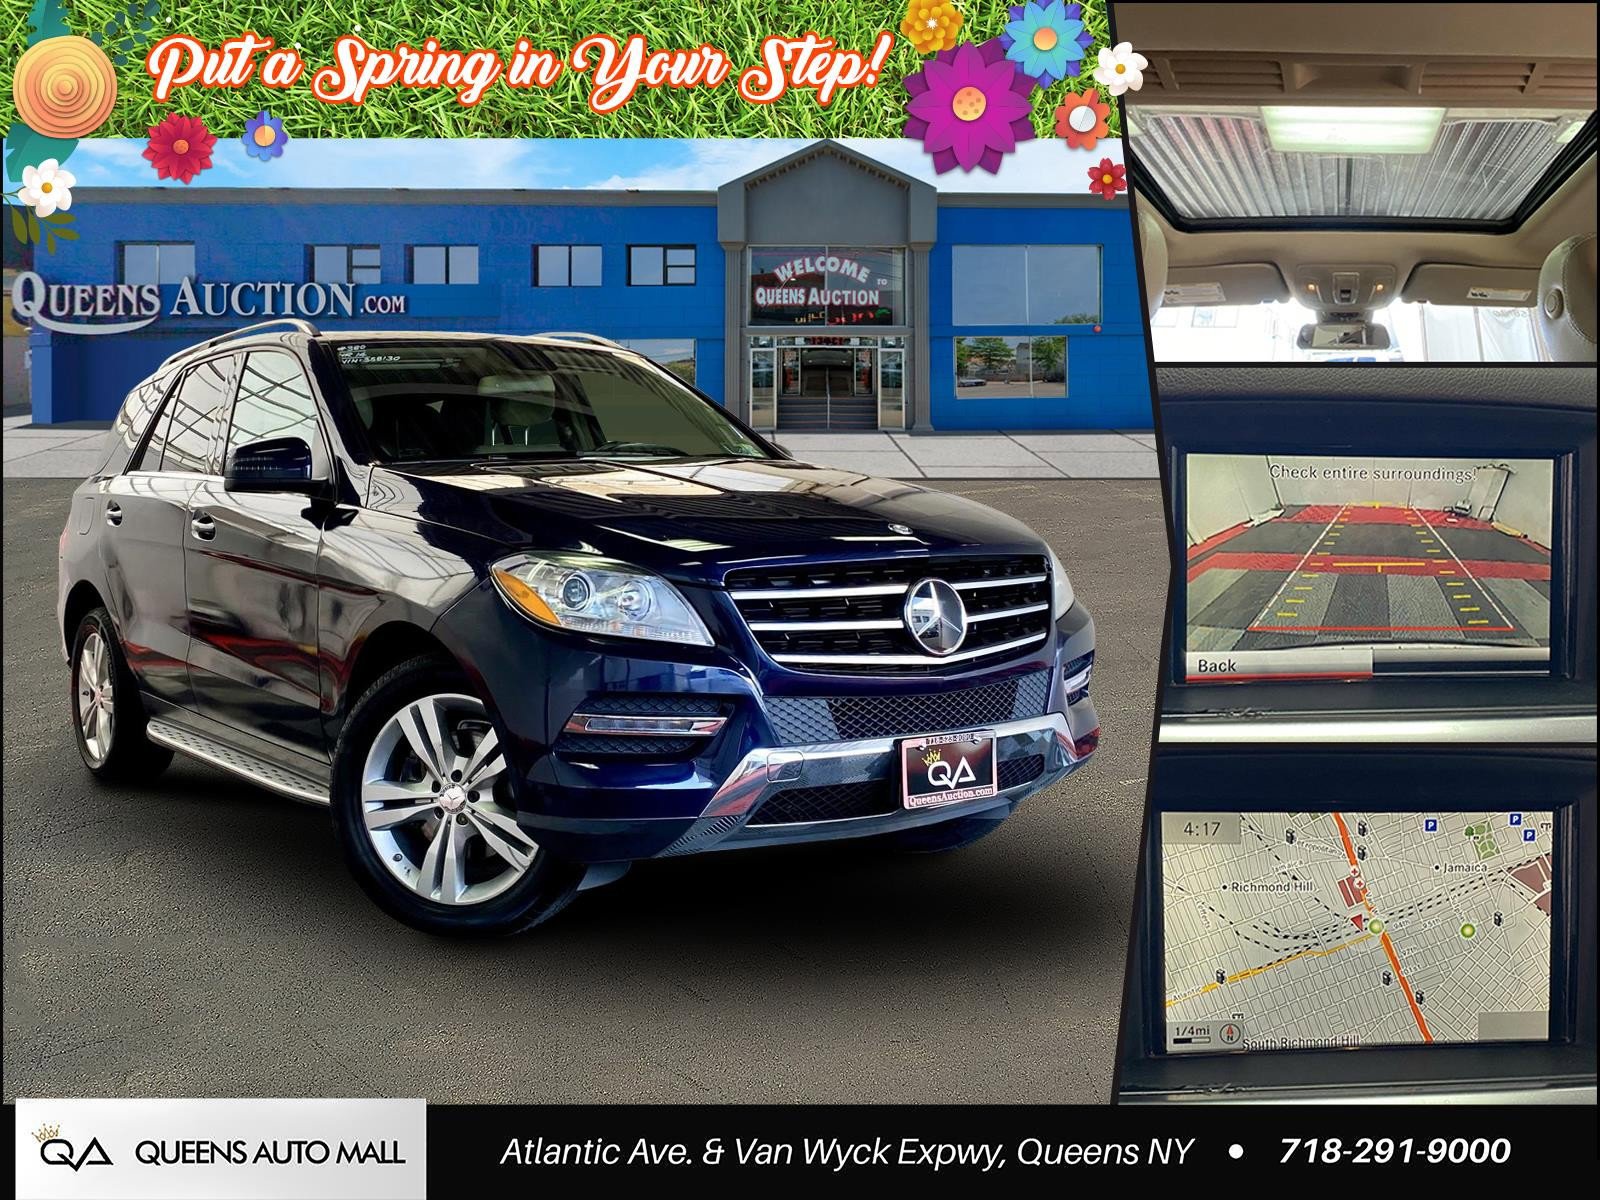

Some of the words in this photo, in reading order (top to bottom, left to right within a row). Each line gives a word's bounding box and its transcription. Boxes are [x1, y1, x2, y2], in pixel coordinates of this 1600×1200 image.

[774, 256, 871, 284] WELCOME
[877, 278, 888, 286] TO
[12, 271, 161, 334] QUEENS
[169, 276, 356, 317] AUCTION
[360, 296, 405, 314] .COM
[755, 287, 806, 307] QUEENS
[807, 287, 880, 306] AUCTION
[1269, 465, 1318, 479] Check
[1323, 466, 1369, 480] entire
[1373, 467, 1478, 484] surroundings!
[1198, 658, 1237, 673] Back
[927, 755, 976, 789] QA
[908, 787, 993, 807] QueensAuction.com
[1183, 821, 1221, 836] 4:17
[1443, 863, 1487, 874] Jamaica
[1231, 881, 1291, 893] Richmond
[1294, 881, 1314, 892] Hill
[1175, 1025, 1210, 1037] 1/4mi
[1243, 1037, 1277, 1050] South
[1280, 1035, 1340, 1049] Richmond
[1340, 1034, 1360, 1048] Hill
